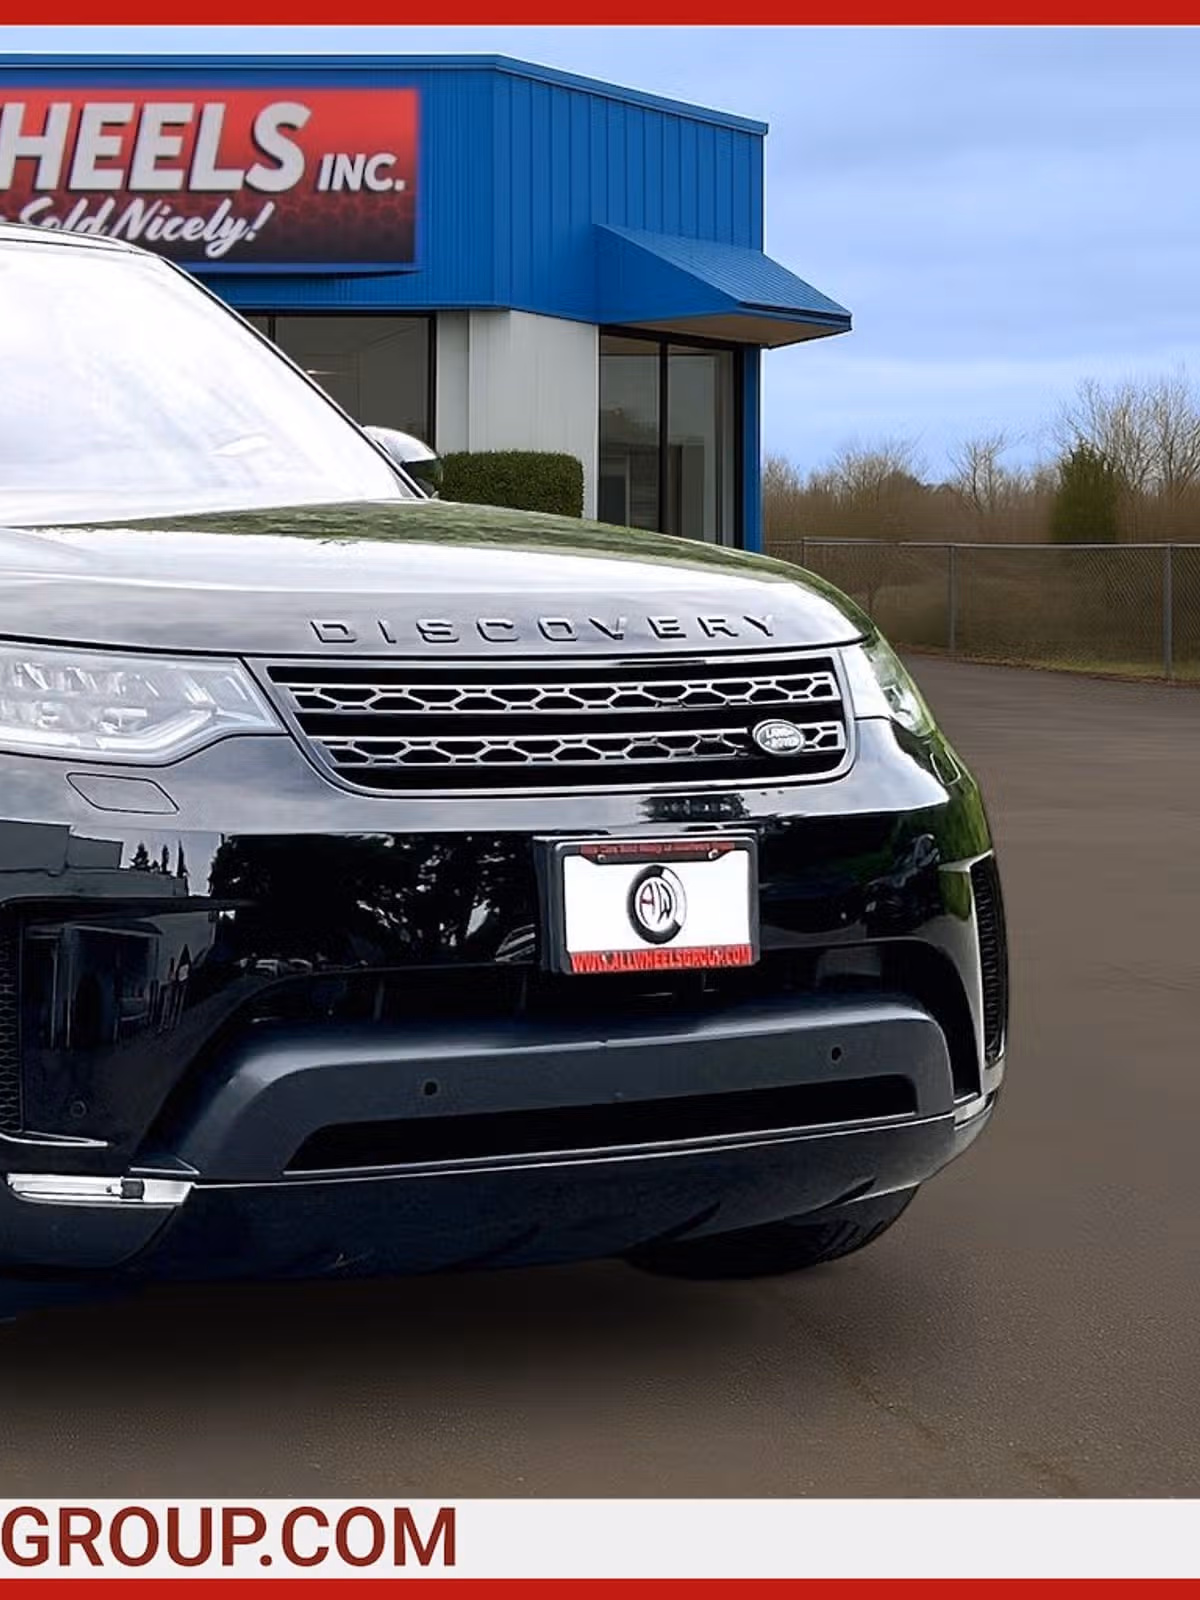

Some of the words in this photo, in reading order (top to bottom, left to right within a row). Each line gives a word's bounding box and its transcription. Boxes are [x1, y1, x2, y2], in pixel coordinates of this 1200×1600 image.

[317, 153, 405, 192] INC.
[109, 198, 275, 258] Nicely!
[310, 615, 775, 643] DISCOVERY
